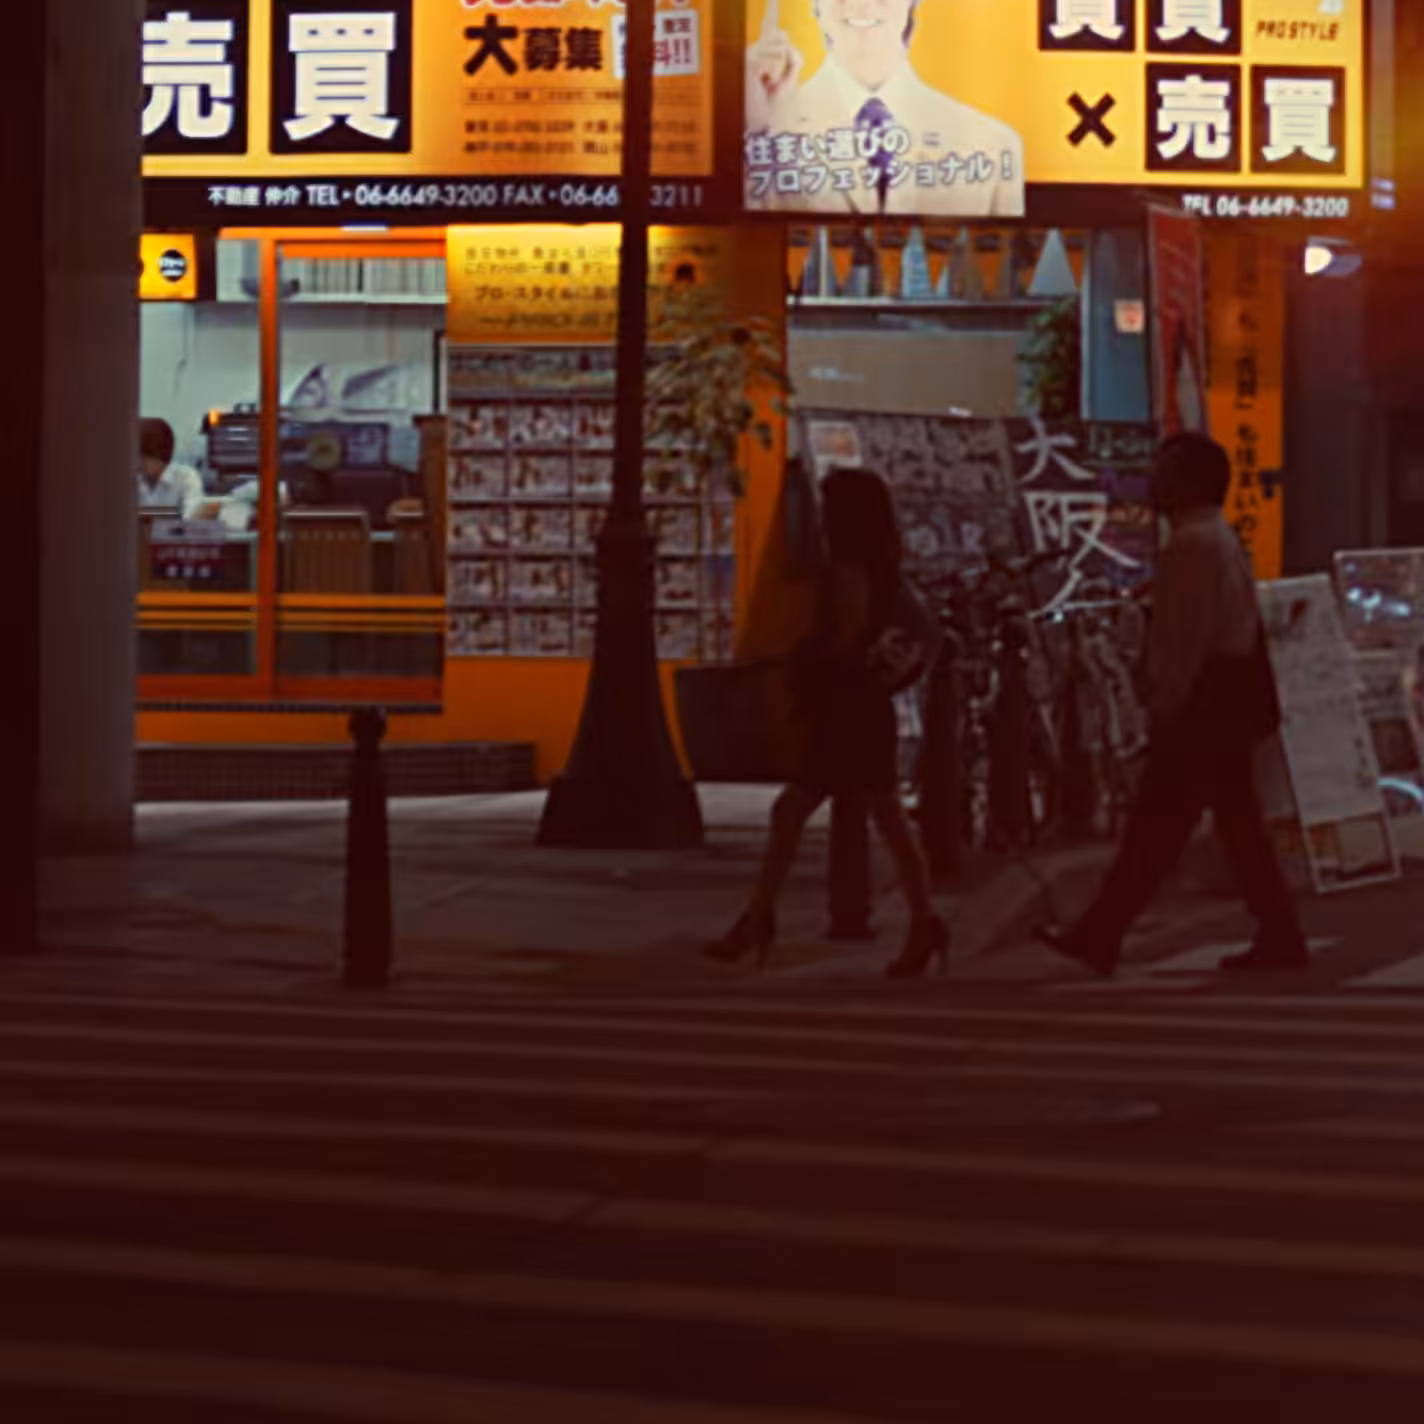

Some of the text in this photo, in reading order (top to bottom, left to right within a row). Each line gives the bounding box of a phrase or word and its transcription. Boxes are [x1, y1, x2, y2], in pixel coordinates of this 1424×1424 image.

[463, 13, 602, 76] 大募集
[744, 121, 910, 166] 住まい選びの
[1156, 76, 1337, 163] 売買
